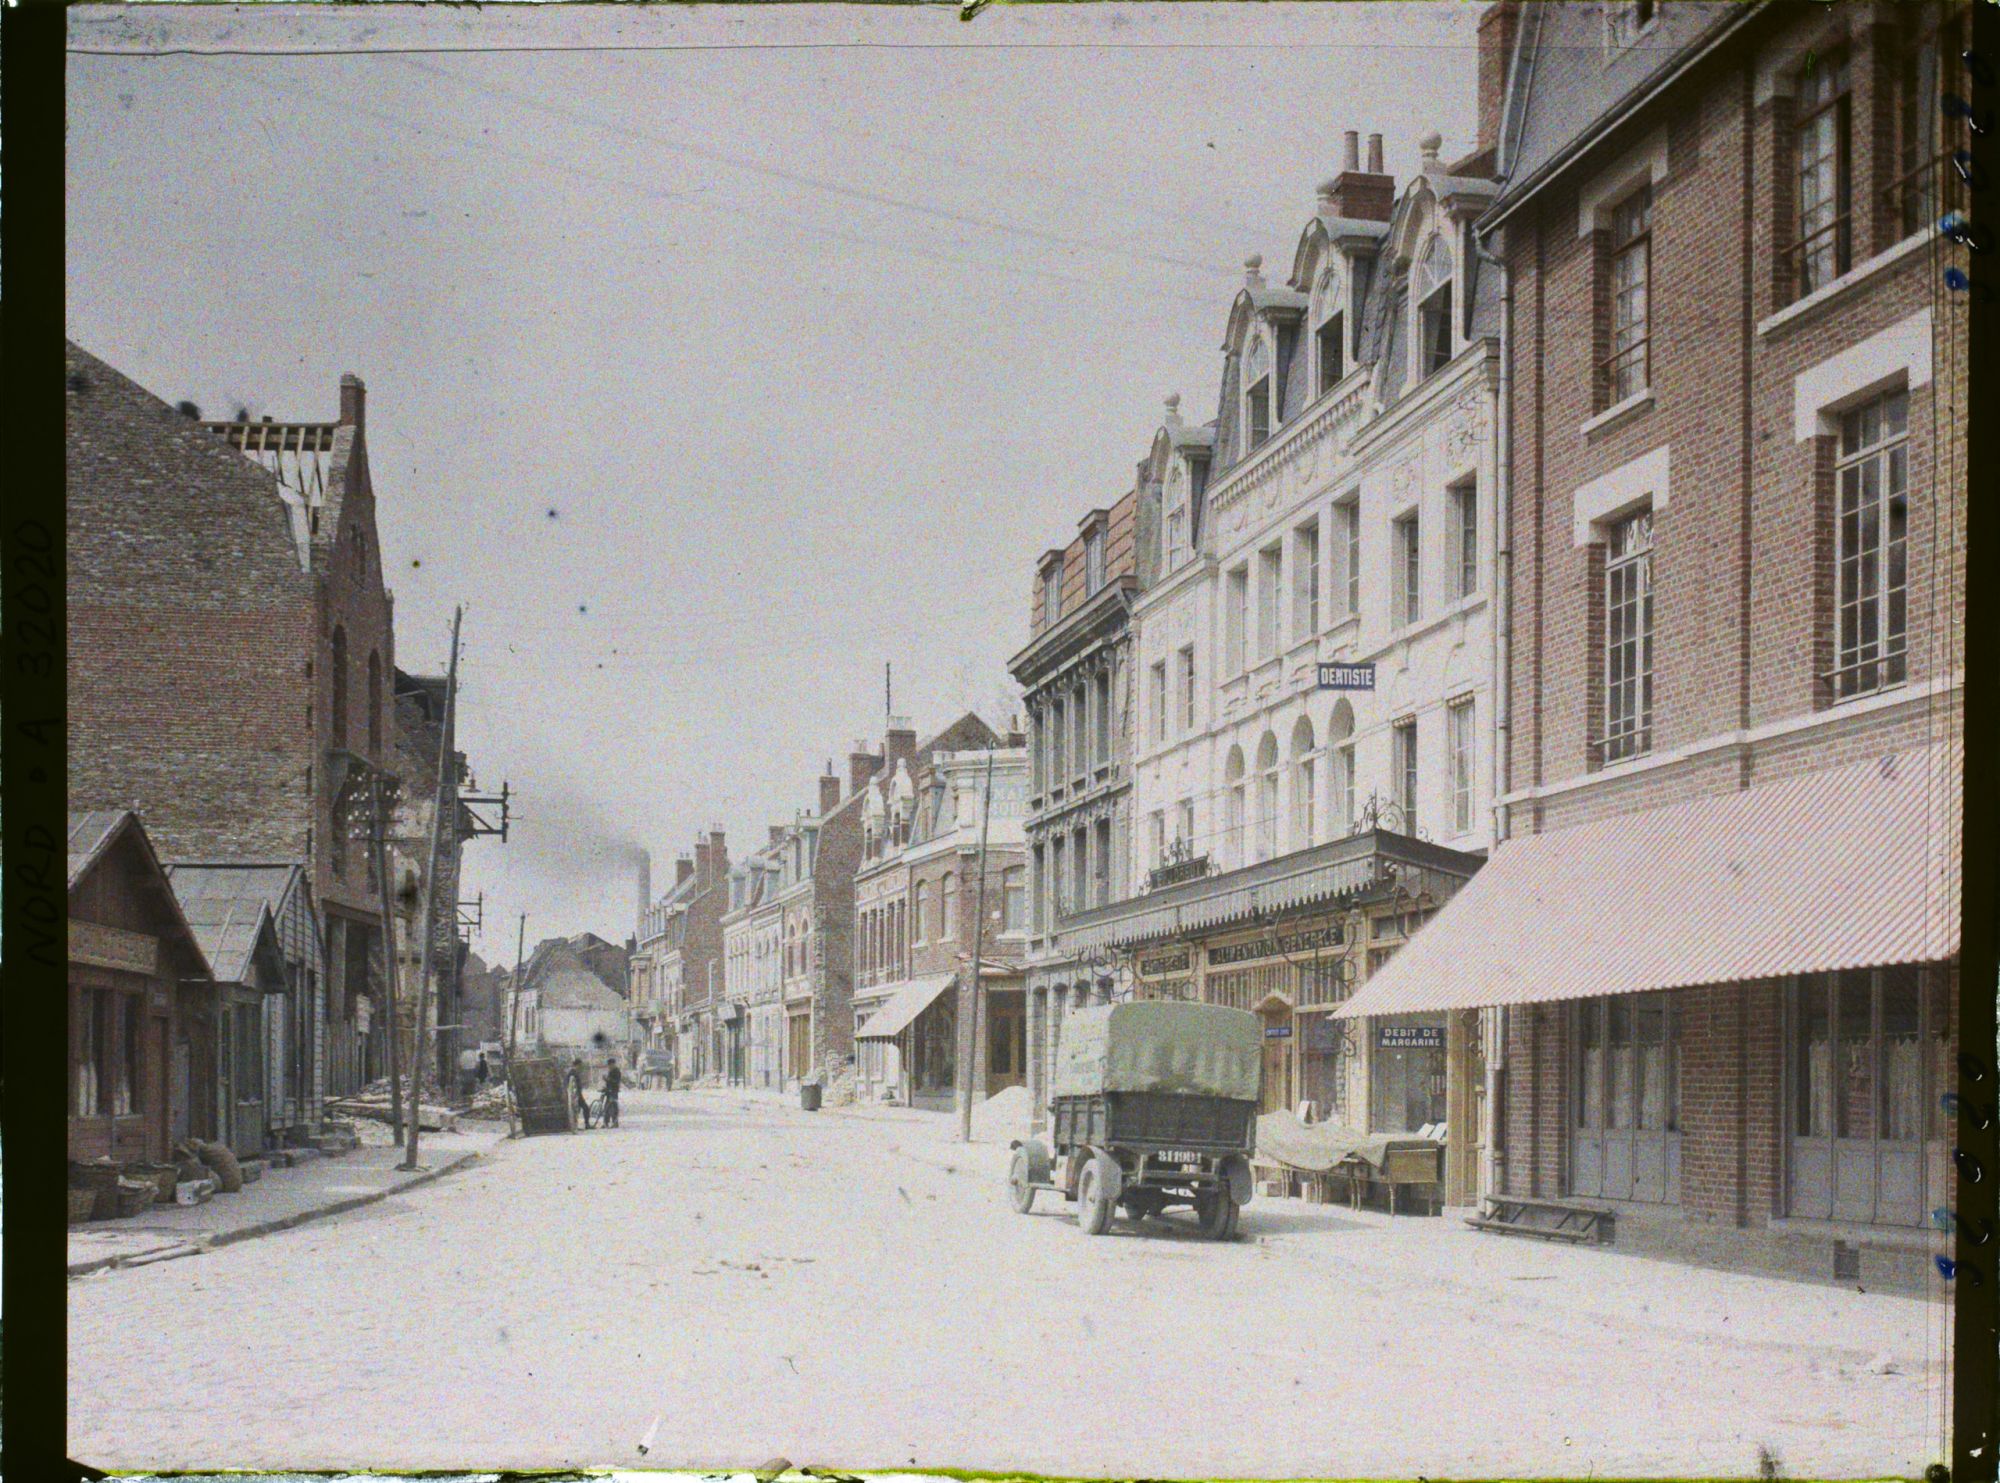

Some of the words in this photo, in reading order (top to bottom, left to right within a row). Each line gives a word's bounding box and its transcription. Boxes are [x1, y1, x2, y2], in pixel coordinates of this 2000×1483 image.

[15, 519, 56, 680] 32020
[1320, 667, 1373, 686] DENTISTE
[17, 716, 63, 747] A
[16, 824, 58, 970] NORD
[1381, 1038, 1441, 1047] MARGARINE
[1384, 1028, 1417, 1037] DEBIT
[1423, 1028, 1439, 1037] DE
